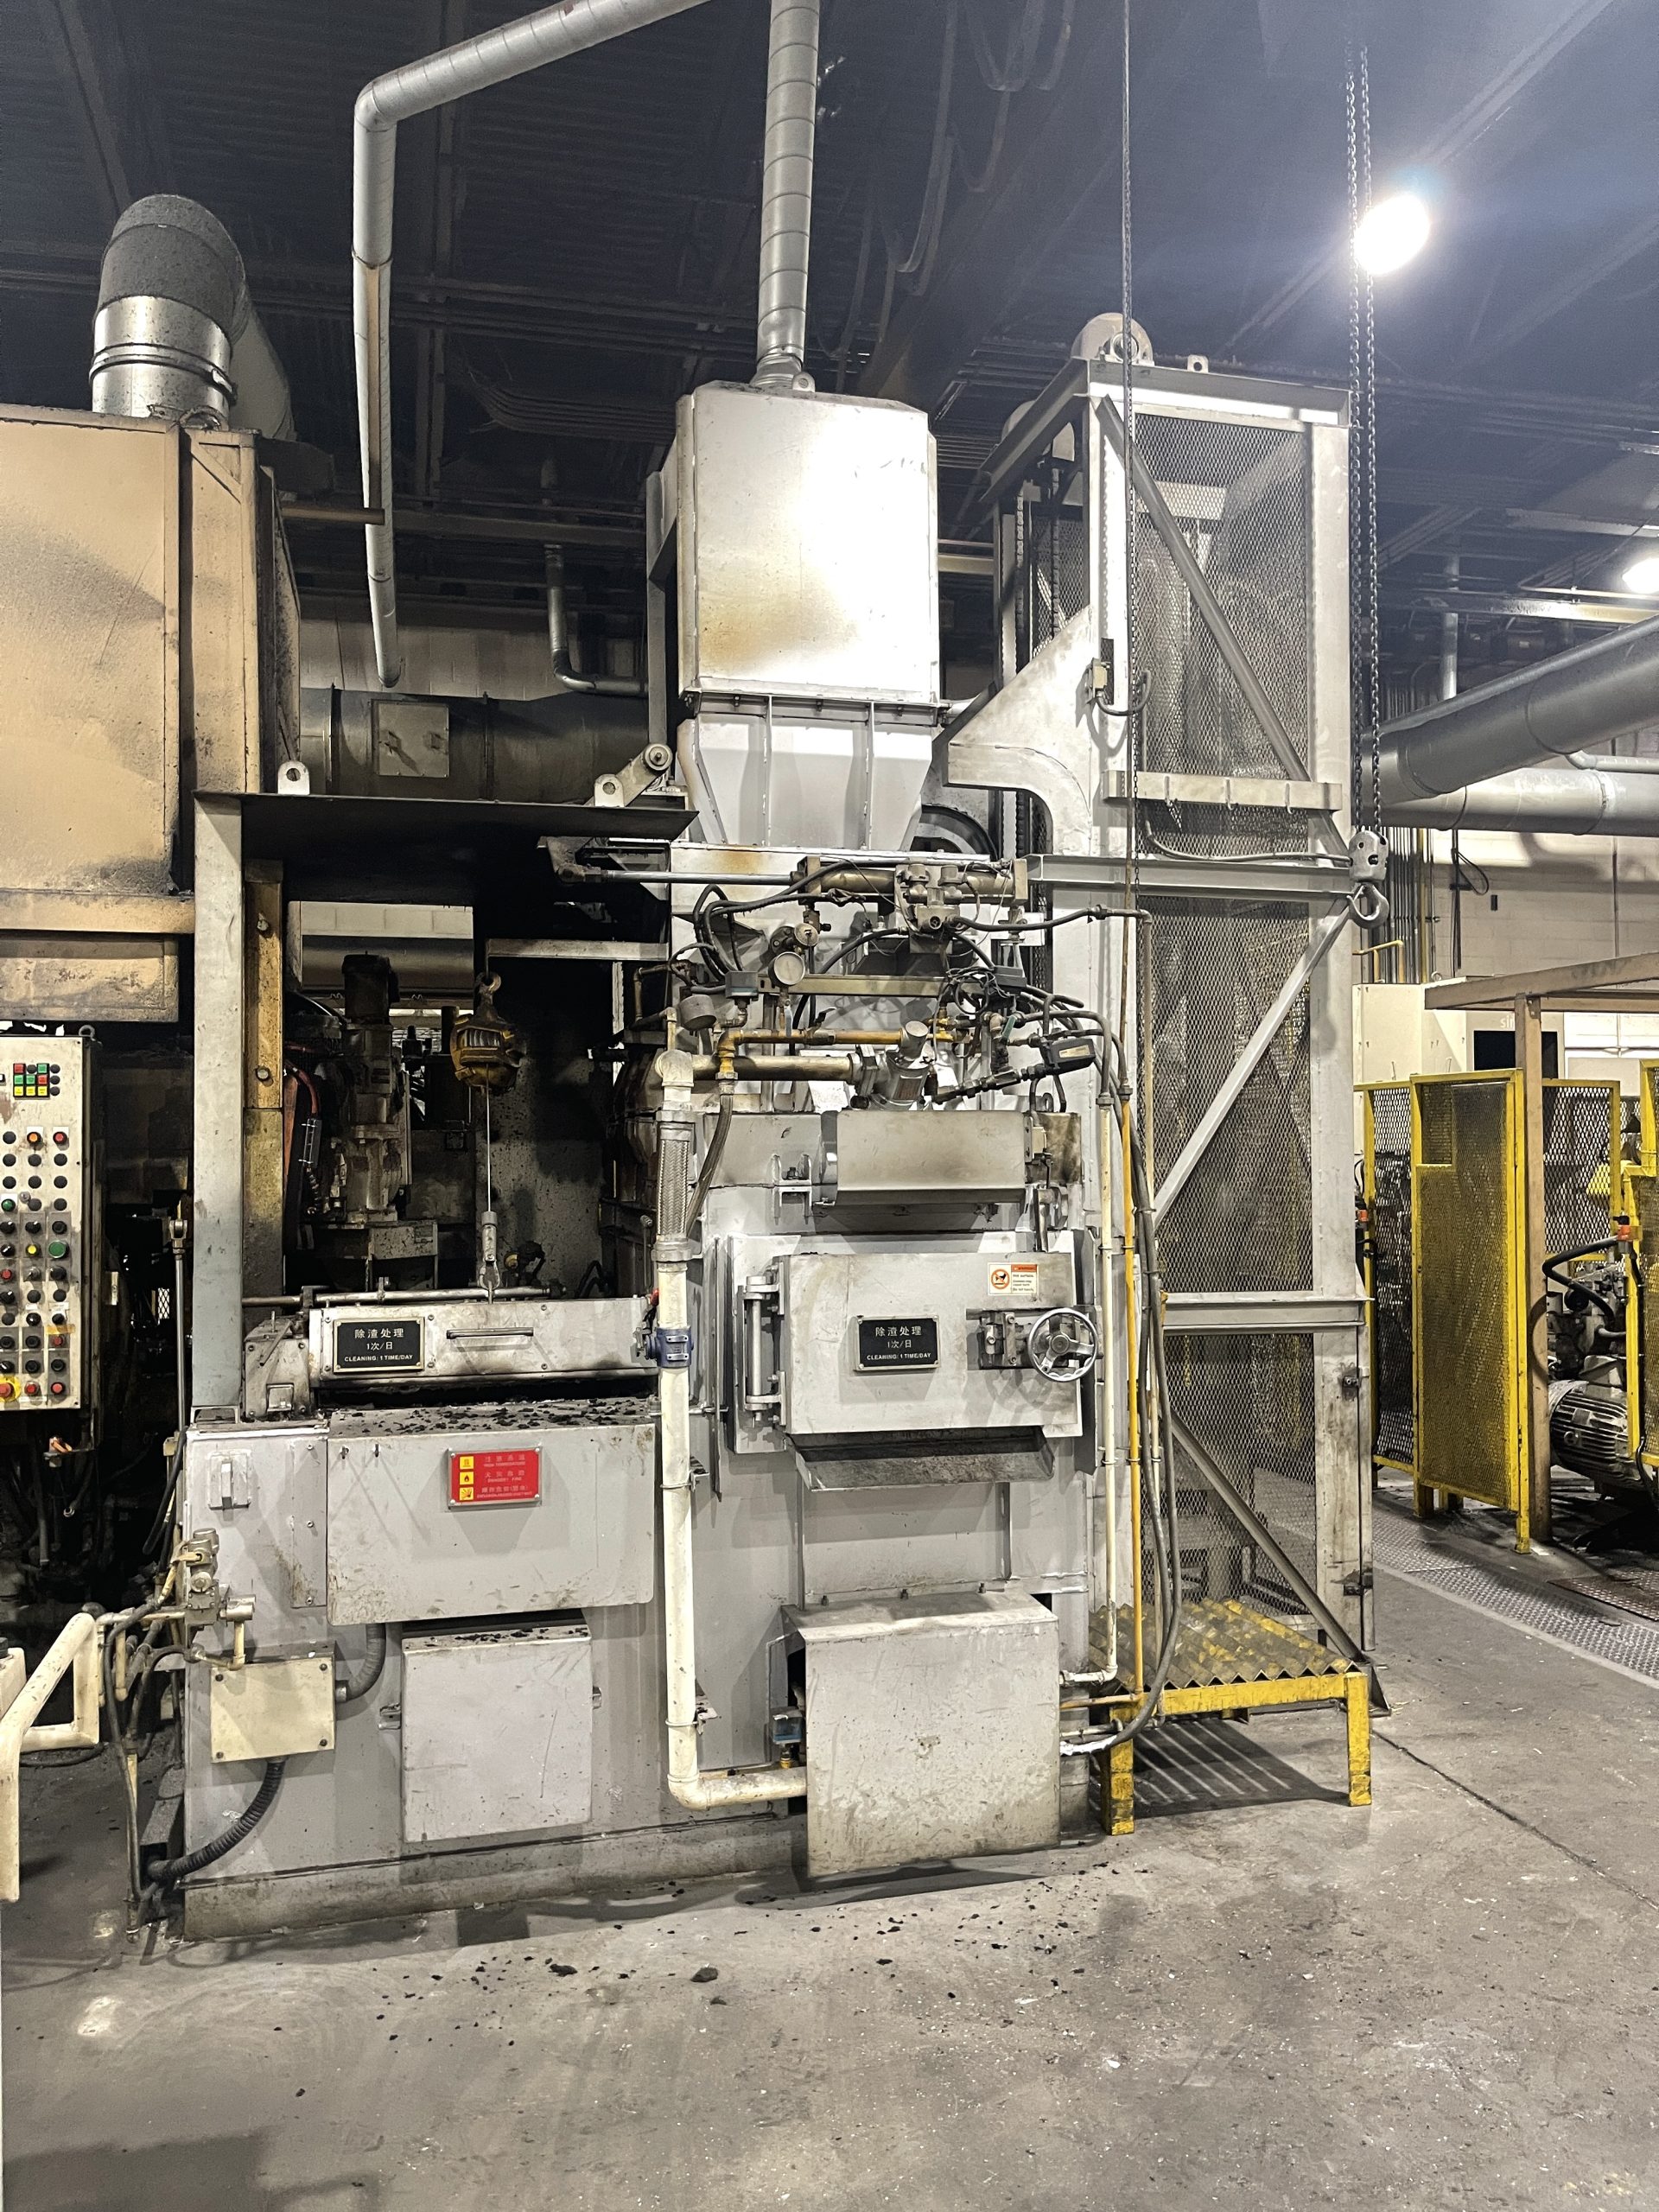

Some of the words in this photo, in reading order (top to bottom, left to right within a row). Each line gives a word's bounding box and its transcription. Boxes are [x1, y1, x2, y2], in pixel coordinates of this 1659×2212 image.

[354, 1328, 404, 1338] 除渣处理
[875, 1325, 922, 1337] 除渣处理
[366, 1341, 393, 1351] 1次/日
